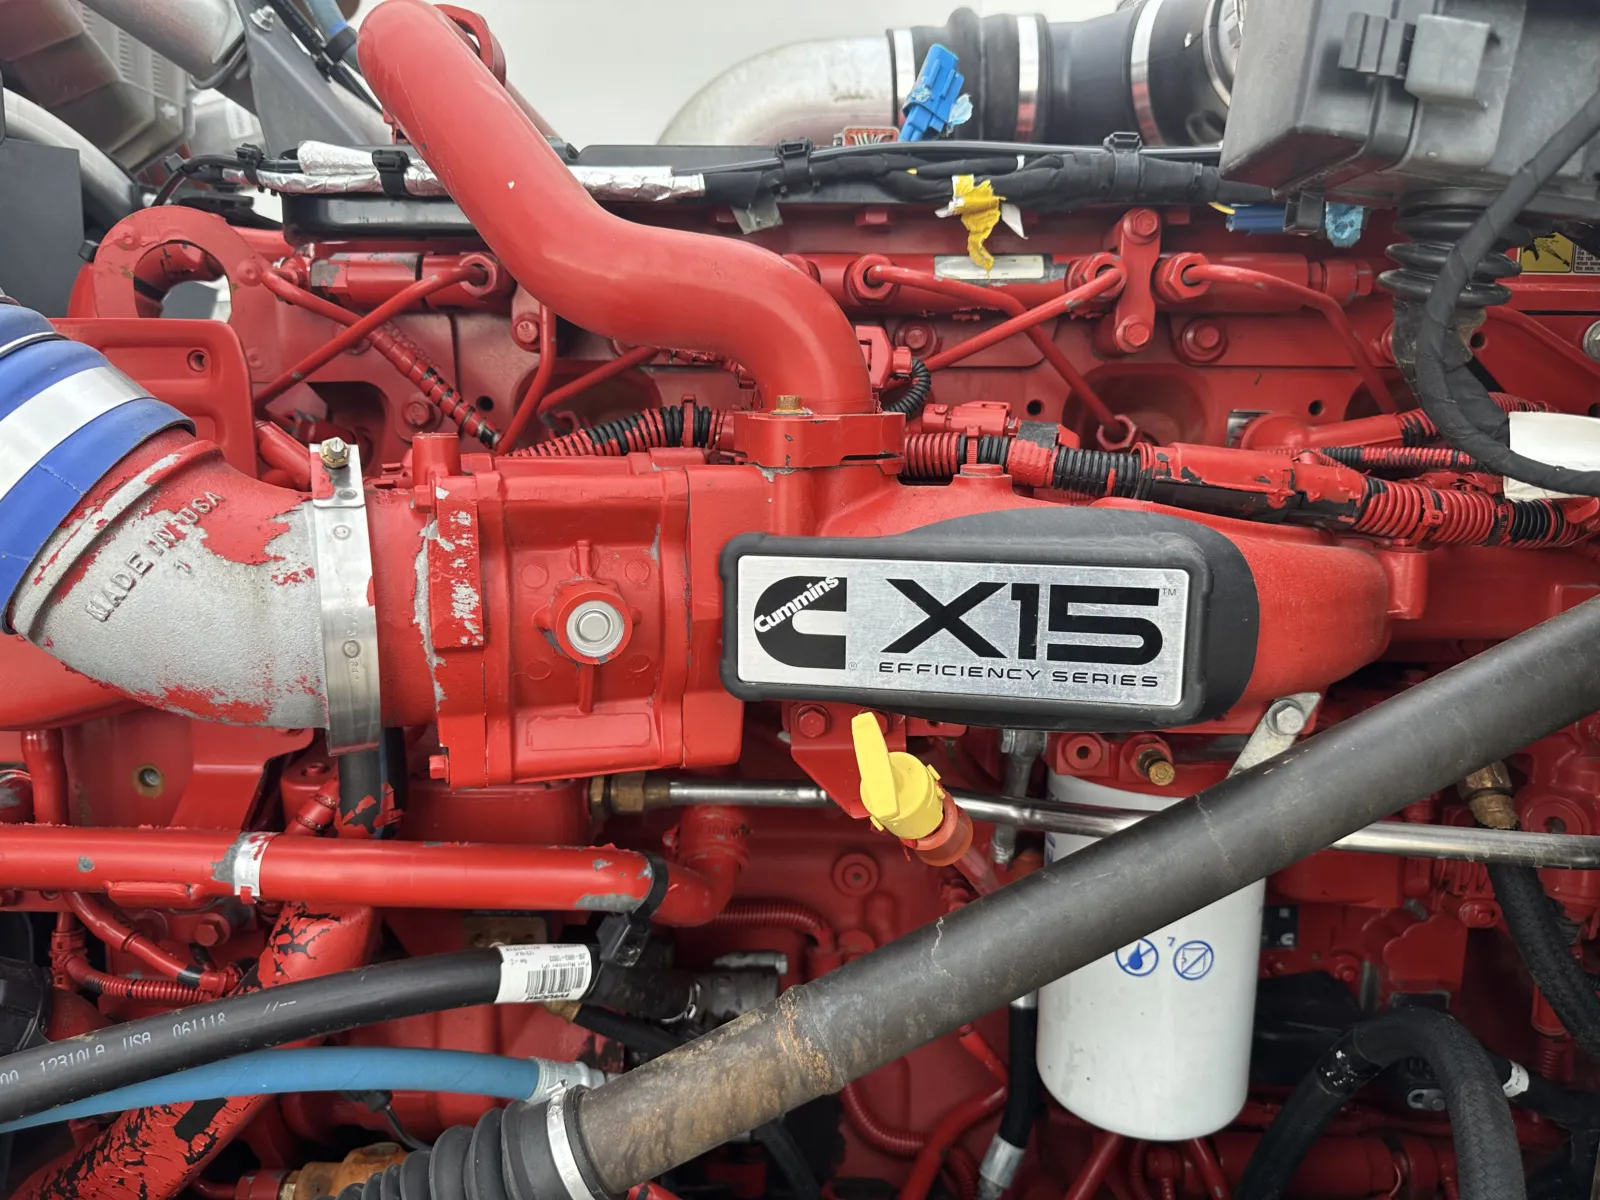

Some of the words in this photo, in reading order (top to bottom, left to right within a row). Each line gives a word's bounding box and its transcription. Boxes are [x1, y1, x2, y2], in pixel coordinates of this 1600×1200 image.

[85, 551, 155, 622] MADE
[144, 523, 180, 557] IN
[175, 491, 226, 526] USA
[754, 576, 840, 633] Cummins
[880, 578, 1164, 666] X15
[878, 661, 1041, 680] EFFICIENCY
[1052, 670, 1158, 687] SERIES
[1166, 935, 1176, 947] 7
